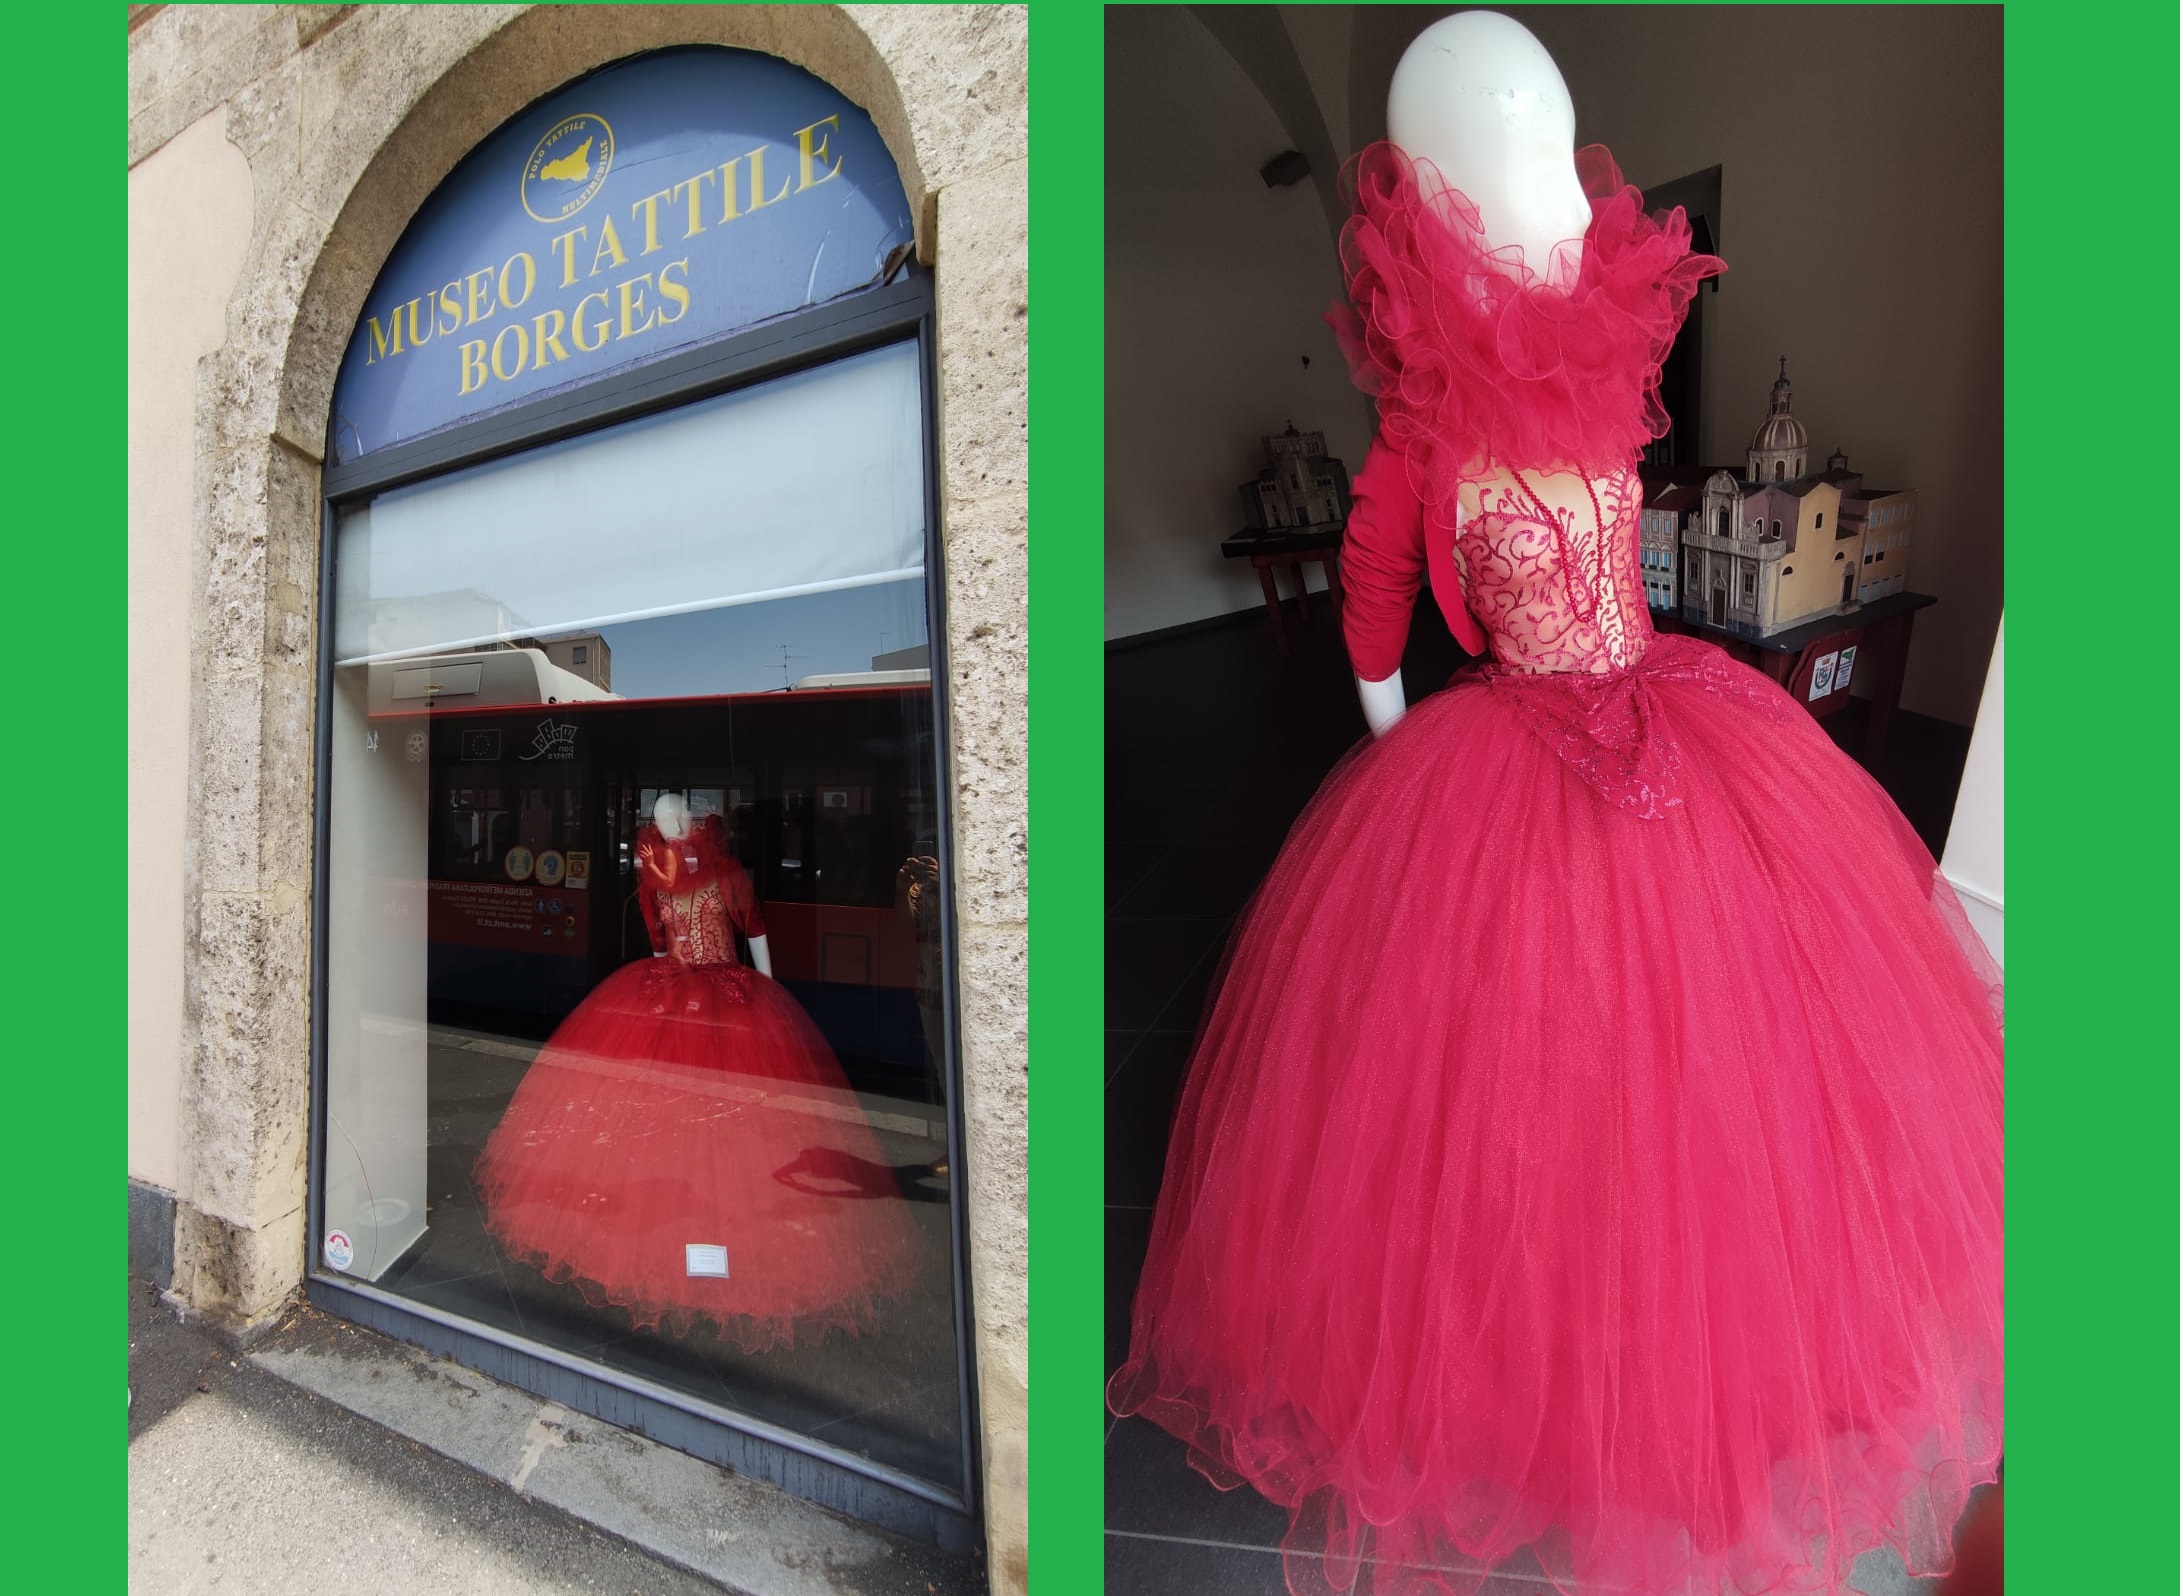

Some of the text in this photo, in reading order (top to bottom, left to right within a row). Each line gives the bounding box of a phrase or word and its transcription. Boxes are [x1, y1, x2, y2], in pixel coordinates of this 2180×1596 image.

[529, 121, 586, 179] POLO TATTILE
[562, 140, 608, 214] MULTIMEDIALE
[366, 113, 844, 366] MUSEO TATTILE
[457, 257, 693, 396] BORGES
